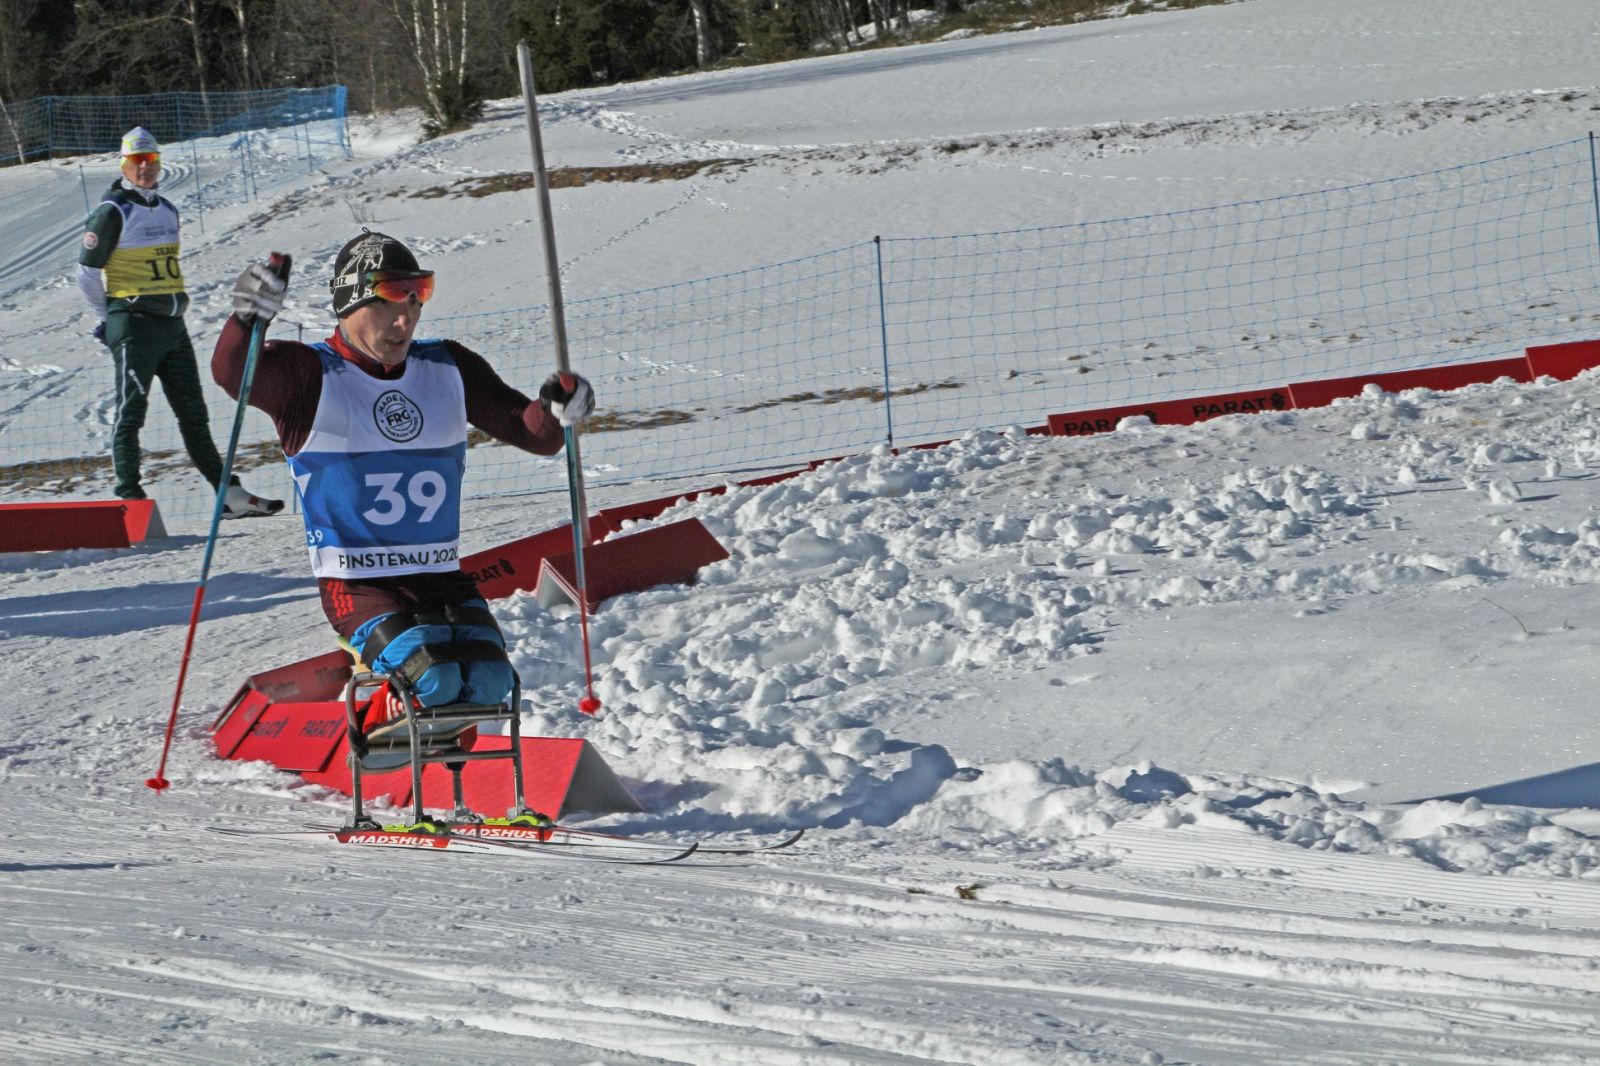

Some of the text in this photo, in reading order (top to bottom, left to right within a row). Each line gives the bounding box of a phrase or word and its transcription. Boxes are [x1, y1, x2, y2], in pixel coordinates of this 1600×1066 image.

[145, 255, 180, 281] 10
[378, 394, 398, 413] MADE
[1192, 397, 1267, 418] PARAT
[1065, 417, 1122, 436] PAR
[363, 470, 447, 526] 39
[307, 529, 323, 544] 39
[338, 551, 429, 569] FINSTERAU
[467, 564, 502, 583] RAT
[348, 834, 435, 847] MADSHUS
[451, 827, 539, 839] MADSHUS
